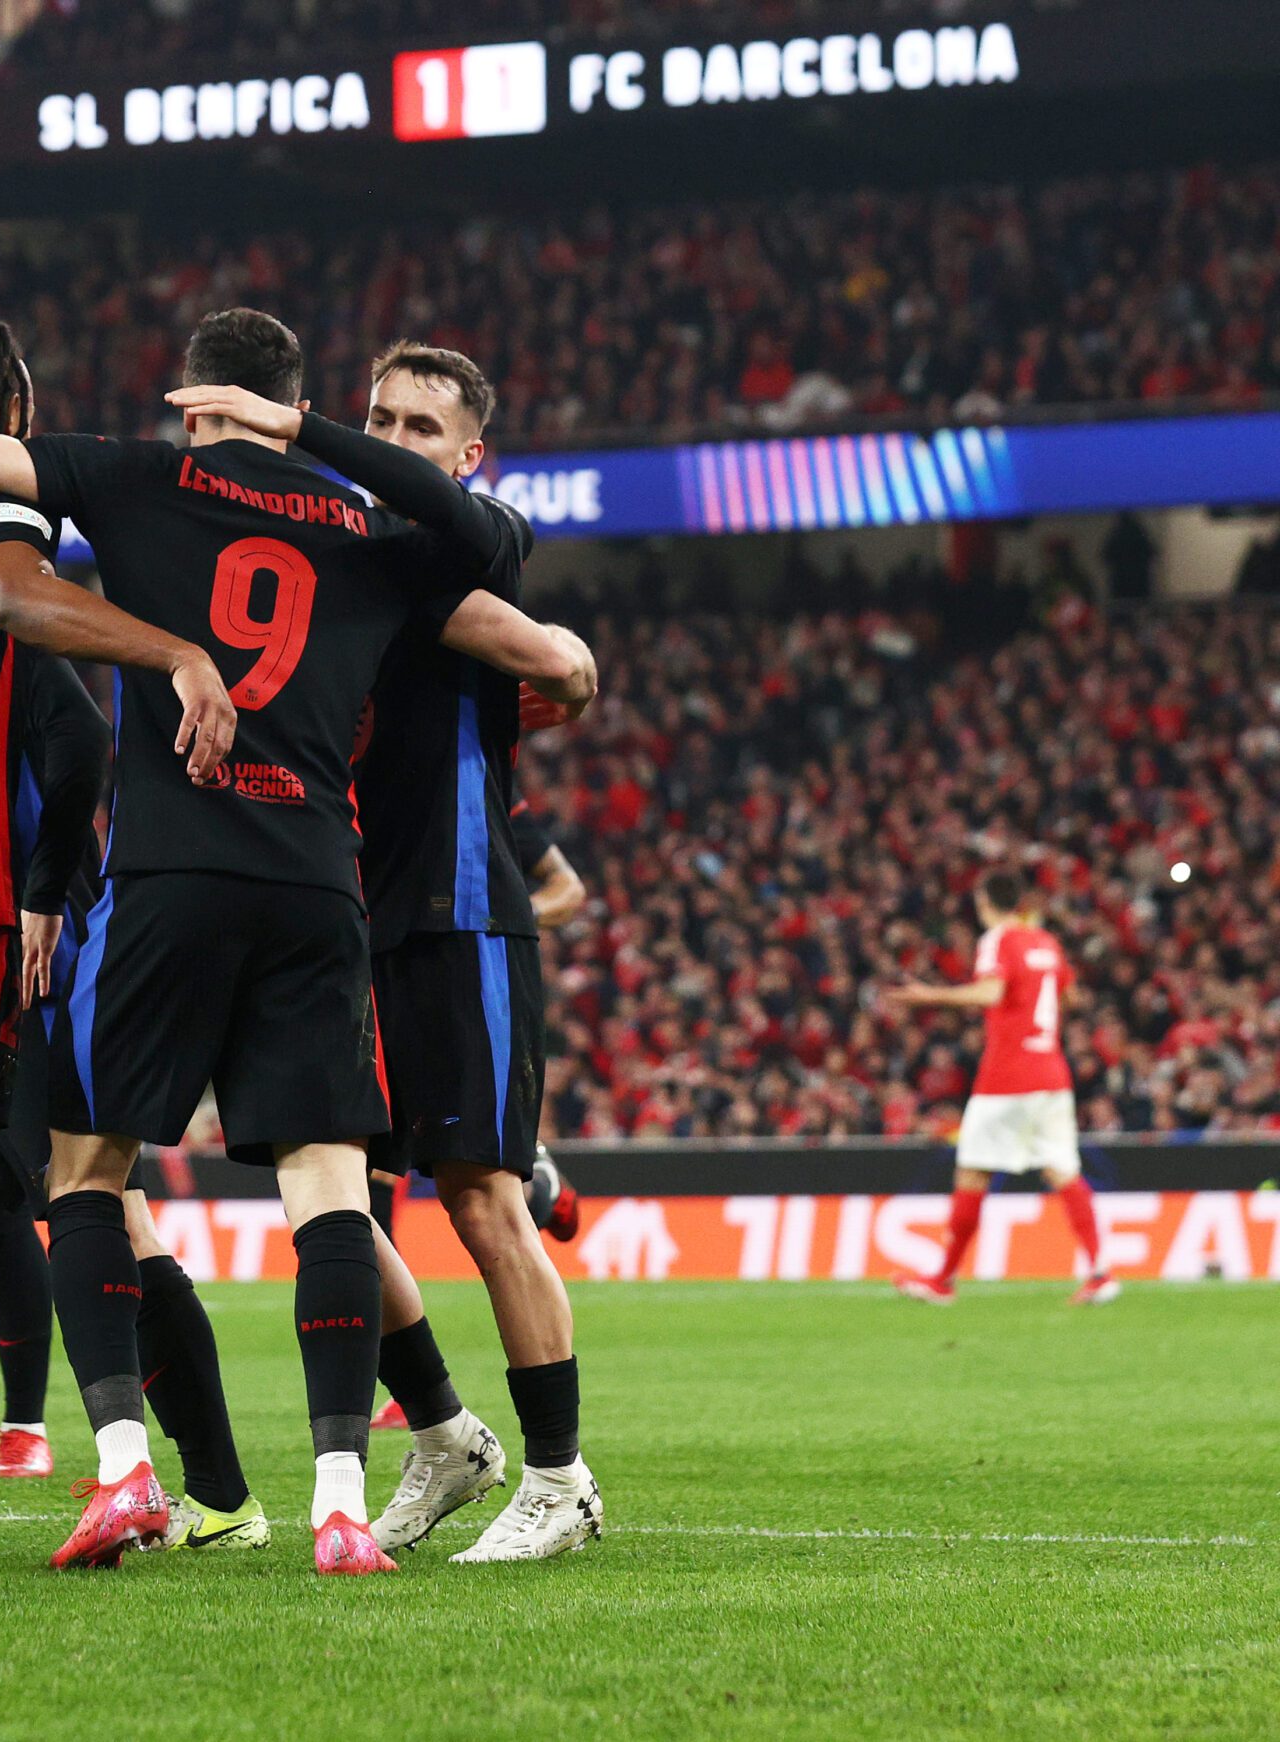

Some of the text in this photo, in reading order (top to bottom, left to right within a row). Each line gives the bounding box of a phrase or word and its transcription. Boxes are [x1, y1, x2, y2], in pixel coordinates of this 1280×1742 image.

[38, 93, 108, 152] SL
[124, 72, 371, 146] BENFICA
[417, 58, 449, 130] 1
[569, 51, 645, 114] FC
[662, 22, 1019, 107] BARCELONA
[209, 536, 318, 712] 9
[234, 778, 306, 800] ACNUR
[722, 1193, 1044, 1282] JUST
